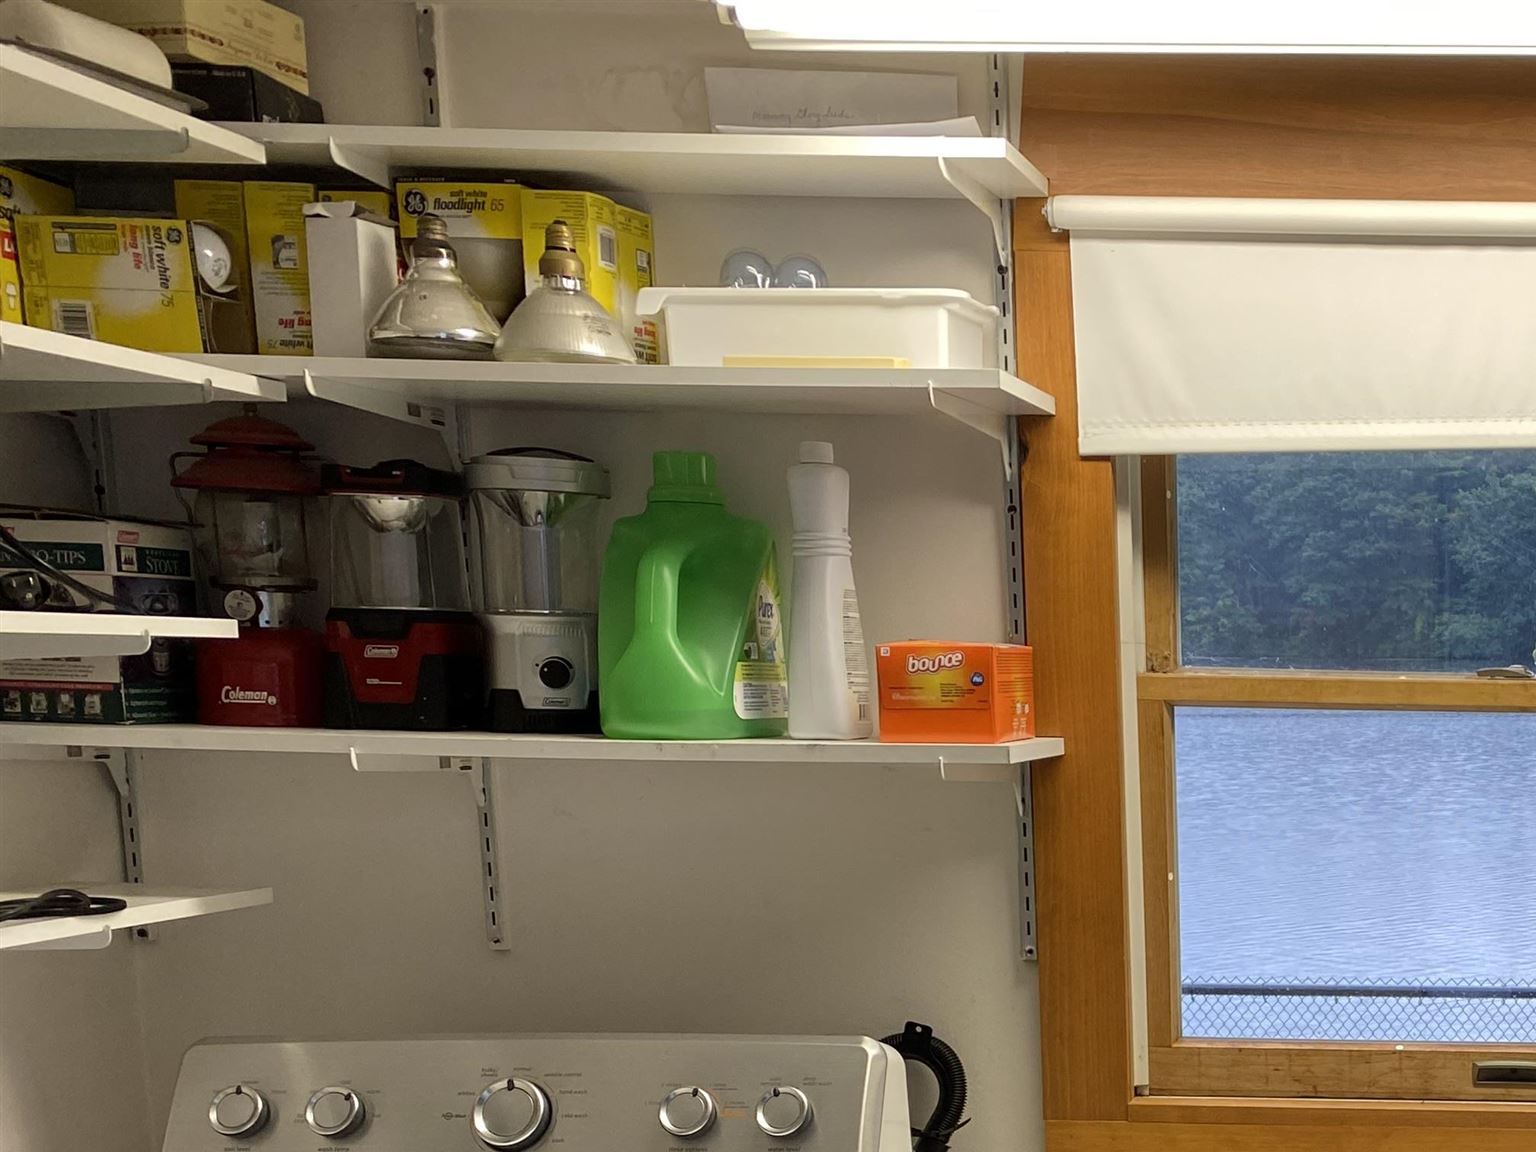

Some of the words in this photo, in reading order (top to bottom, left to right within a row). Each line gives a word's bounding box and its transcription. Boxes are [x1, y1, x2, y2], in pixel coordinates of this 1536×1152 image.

[433, 197, 486, 213] floodlight
[490, 199, 505, 212] 65
[128, 224, 139, 249] long
[152, 225, 167, 251] soft
[132, 252, 144, 270] life
[156, 252, 171, 289] white
[160, 292, 175, 309] 75
[758, 594, 774, 619] Purex
[907, 652, 963, 674] bounce
[221, 686, 268, 703] Coleman
